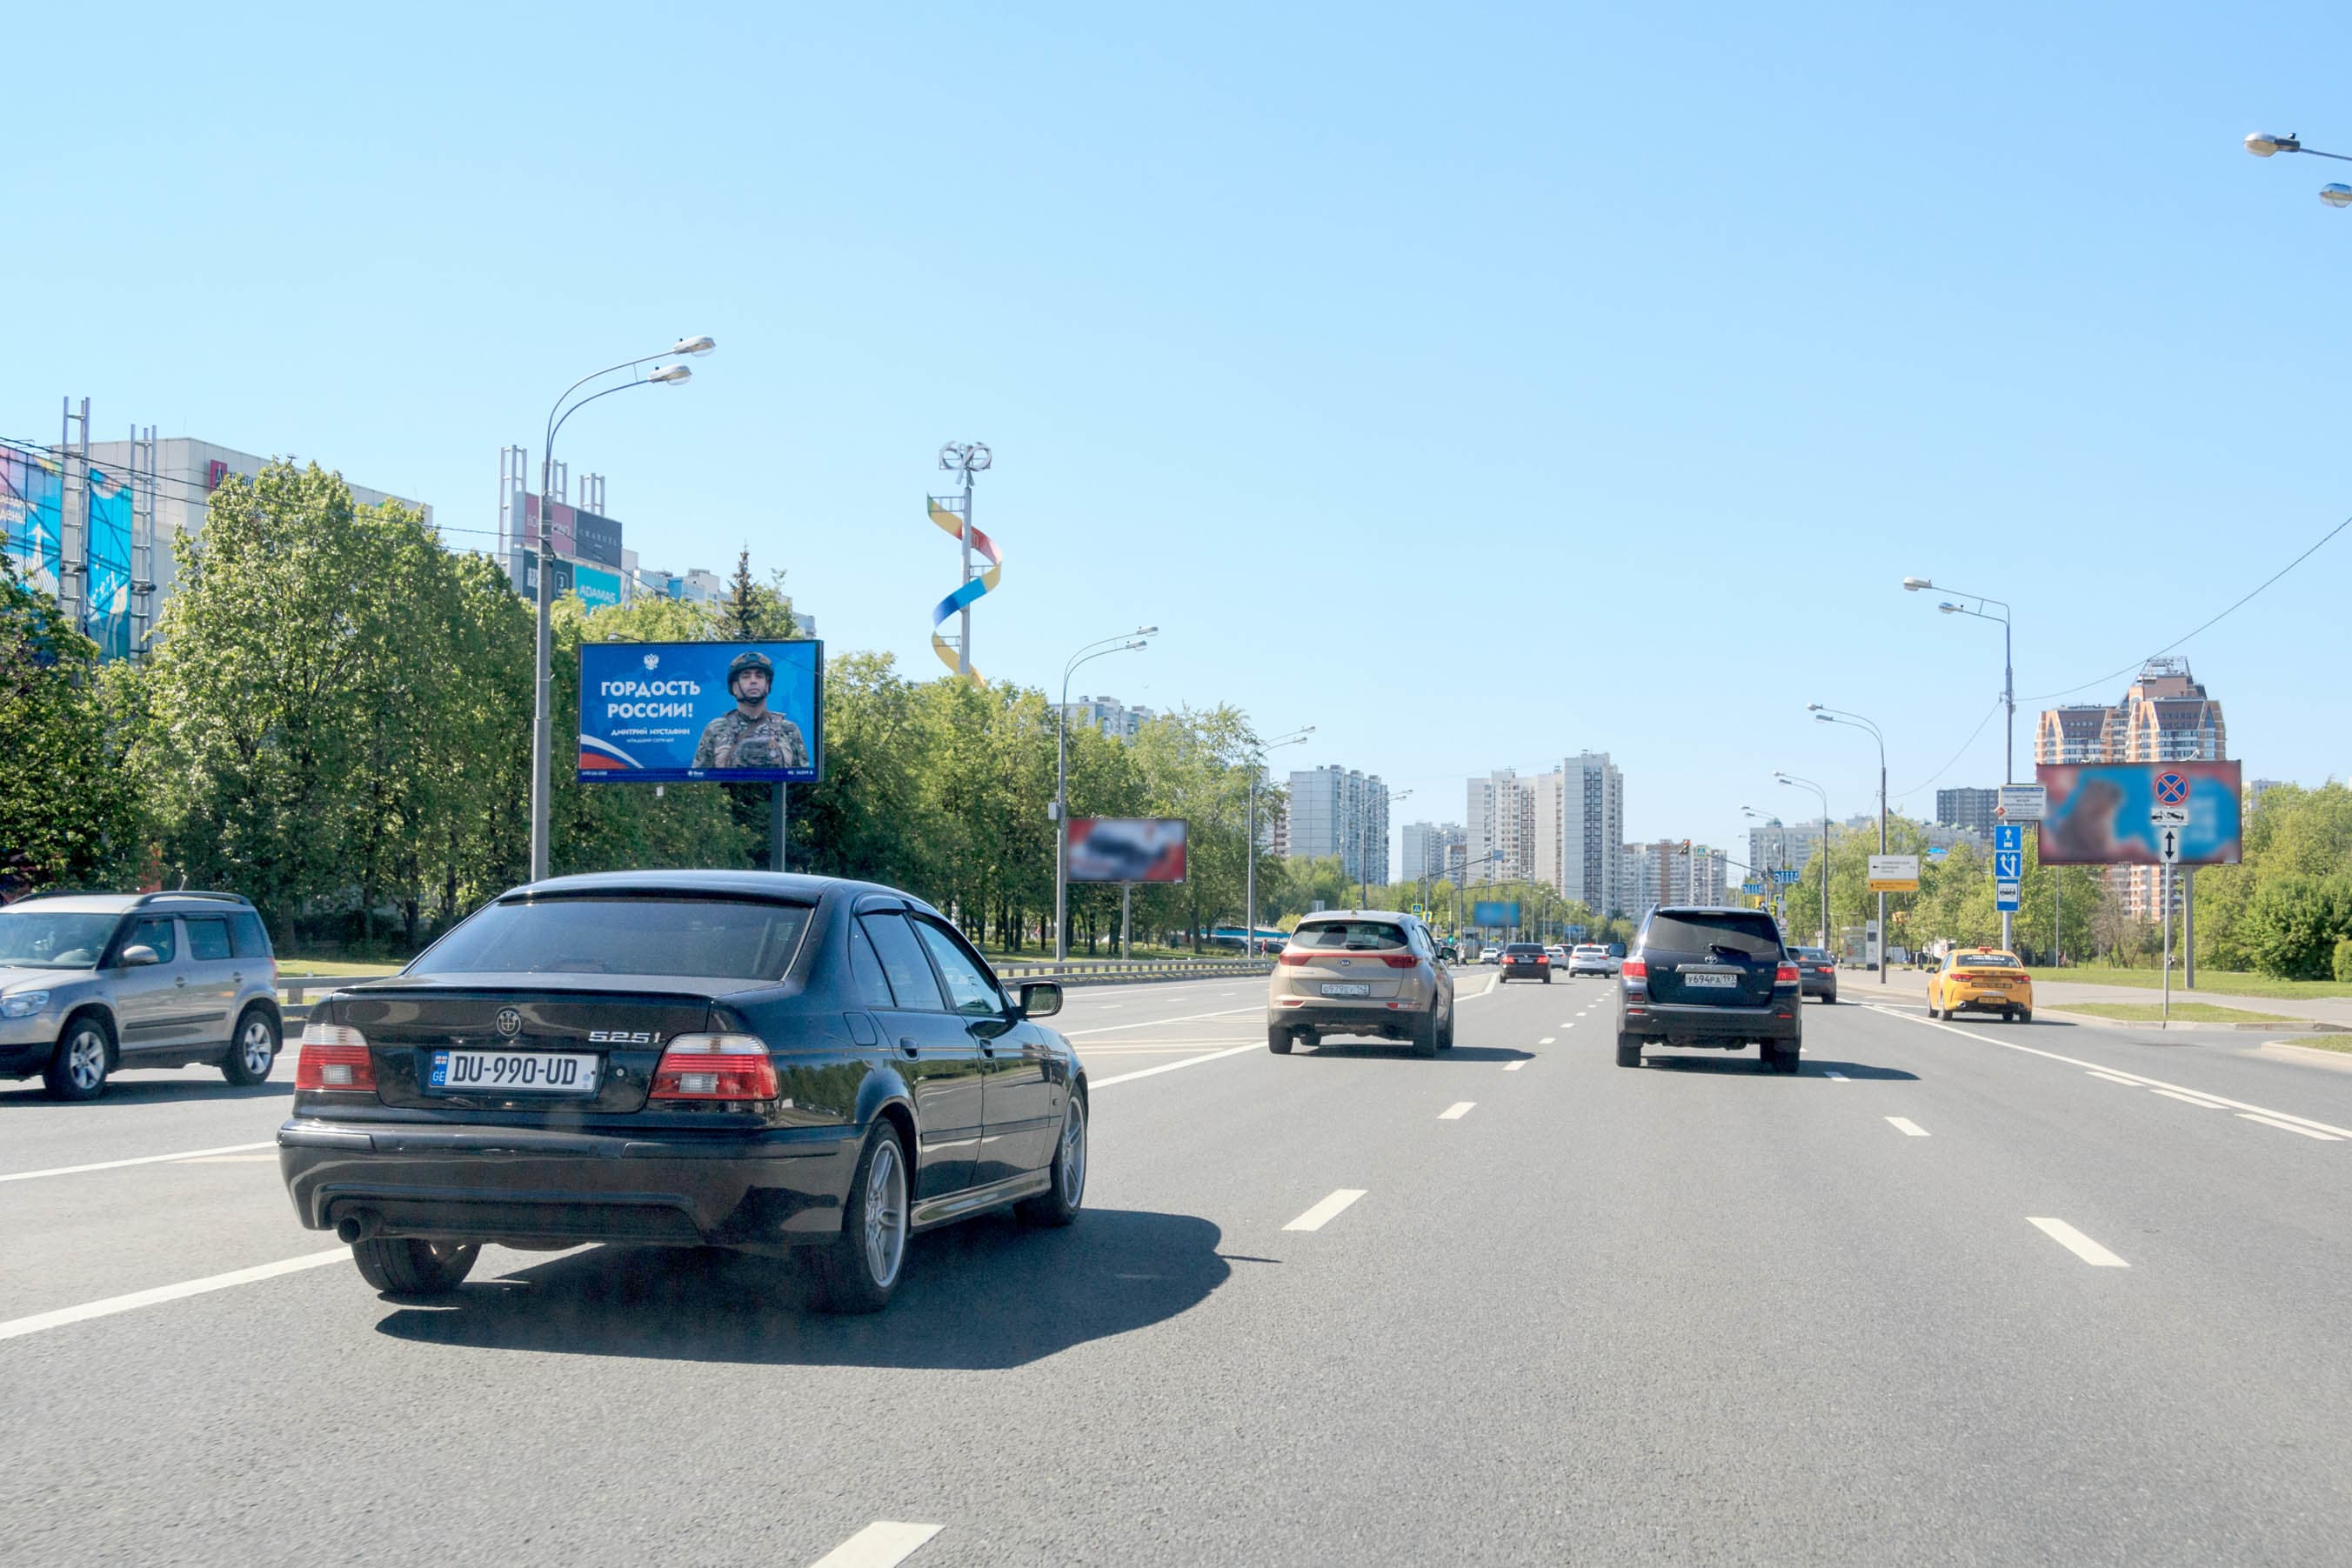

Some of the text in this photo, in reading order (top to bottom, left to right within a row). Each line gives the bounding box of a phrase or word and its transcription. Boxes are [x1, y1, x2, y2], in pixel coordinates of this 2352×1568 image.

[579, 584, 616, 604] ADAMAS
[601, 681, 701, 697] ГОРДОСТЬ
[607, 703, 693, 718] РОССИИ!
[432, 1071, 445, 1081] GE
[451, 1055, 578, 1084] DU-990-UD
